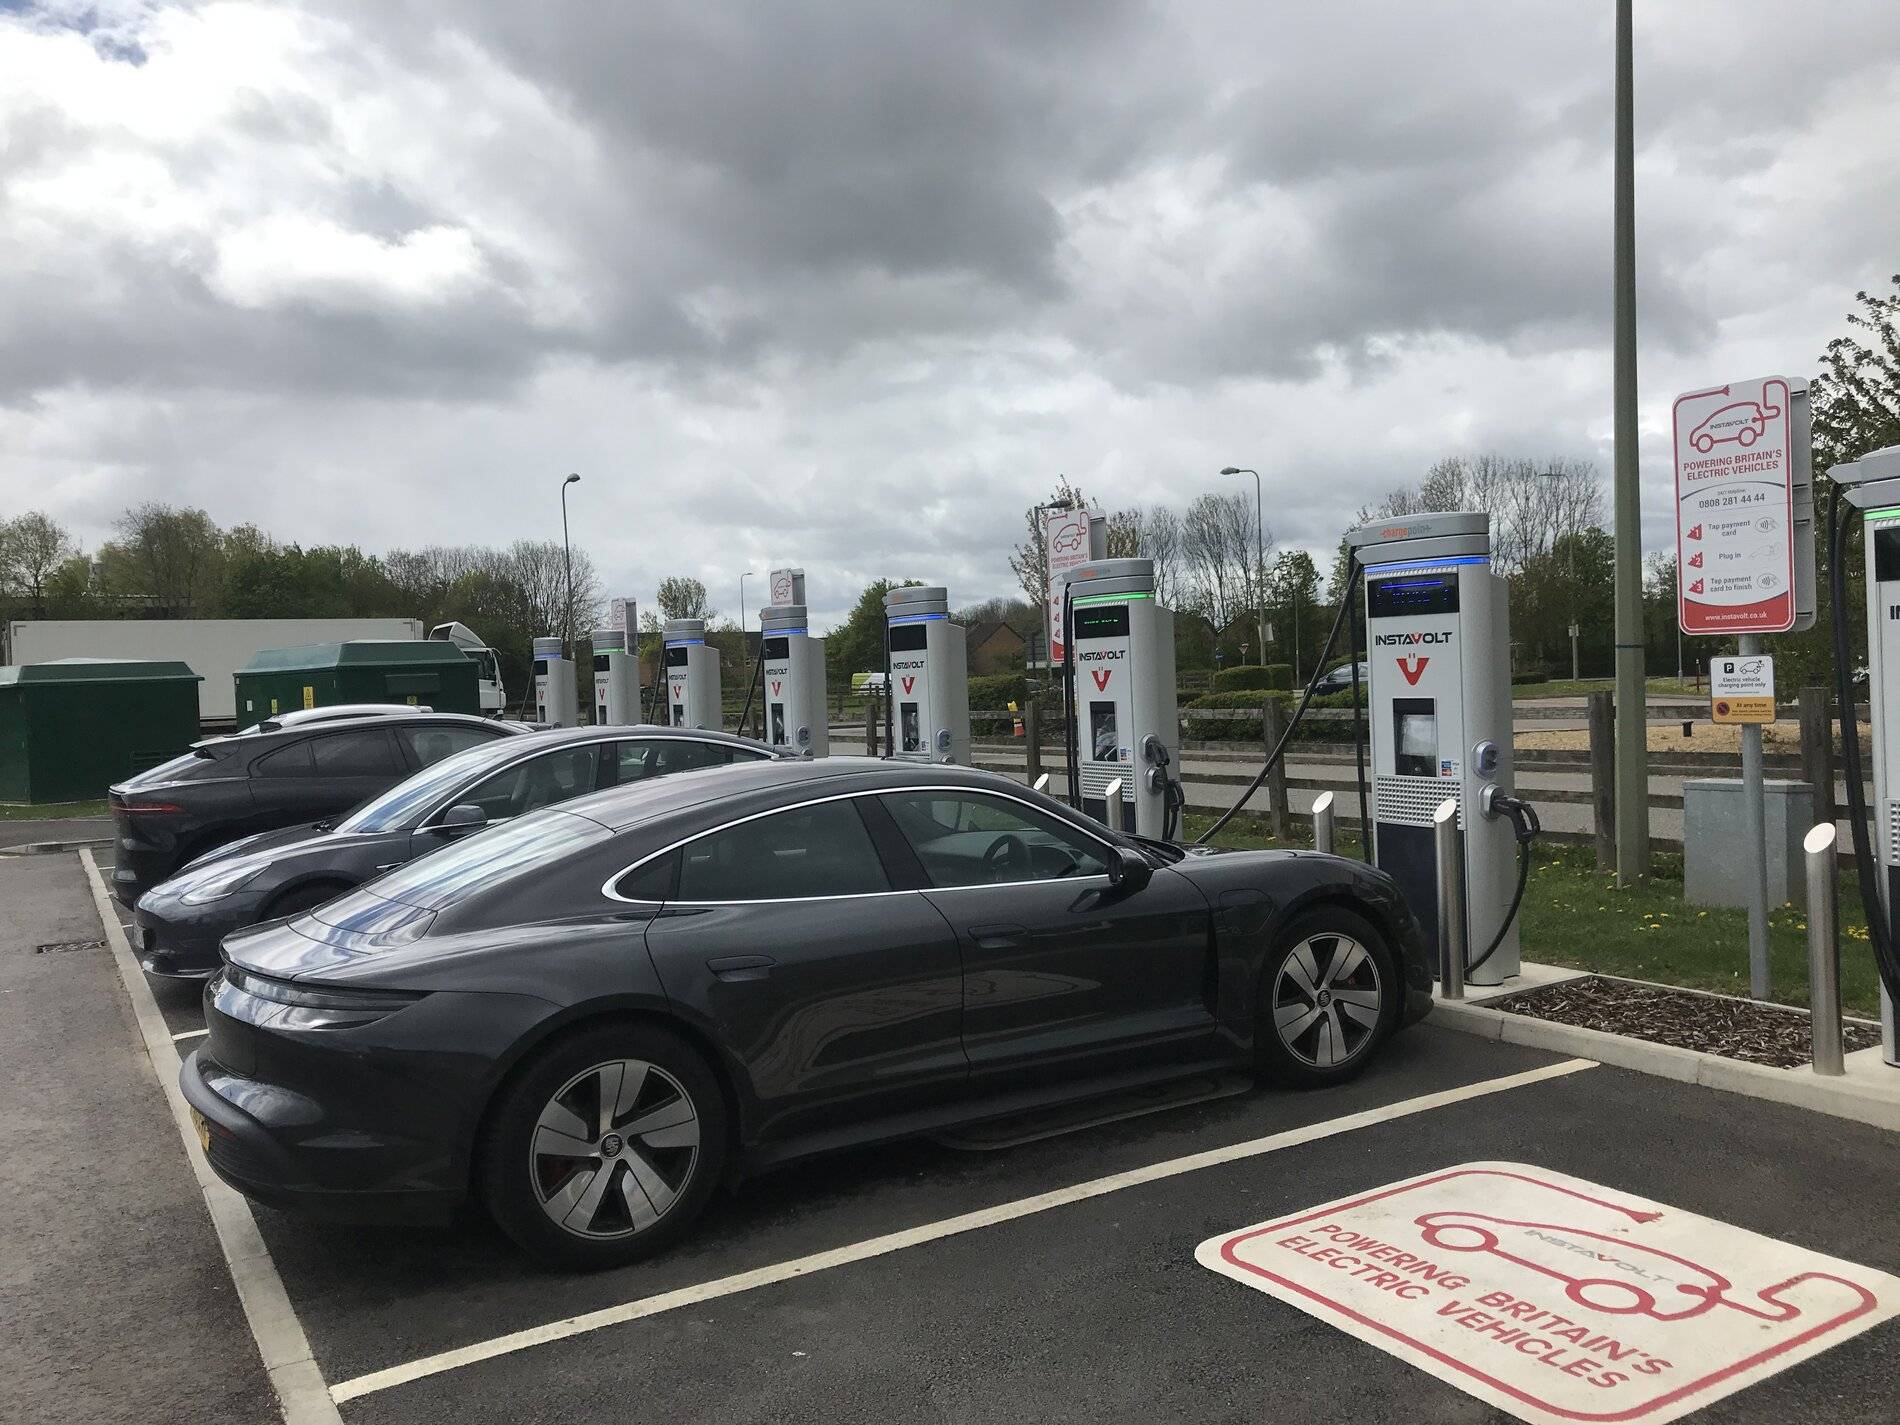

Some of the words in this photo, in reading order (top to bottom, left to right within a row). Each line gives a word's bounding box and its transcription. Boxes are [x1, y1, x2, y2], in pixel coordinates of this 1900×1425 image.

[1710, 418, 1749, 430] INSTAVOLT
[1683, 456, 1732, 471] POWERING
[1734, 449, 1782, 464] BRITAIN'S
[1687, 467, 1730, 480] ELECTRIC
[1732, 460, 1778, 474] VEHICLES
[1699, 498, 1720, 508] 0808
[1723, 496, 1738, 506] 281
[1740, 494, 1751, 504] 44
[1754, 492, 1764, 502] 44
[1722, 520, 1750, 530] payment
[1696, 529, 1699, 538] 1
[1696, 557, 1701, 566] 2
[1718, 552, 1734, 560] Plug
[1724, 576, 1752, 584] payment
[1696, 583, 1702, 591] 3
[1705, 611, 1768, 620] www.instavolt.co.uk
[1376, 632, 1452, 646] INSTAVOLT
[1079, 650, 1126, 662] INSTAVOLT
[892, 661, 924, 670] INSTAVOLT
[1524, 1229, 1675, 1284] INSTAVOLT
[1310, 1224, 1471, 1290] POWERING
[1474, 1292, 1674, 1376] BRITAIN'S
[1275, 1235, 1430, 1300] ELECTRIC
[1436, 1300, 1630, 1388] VEHICLES
